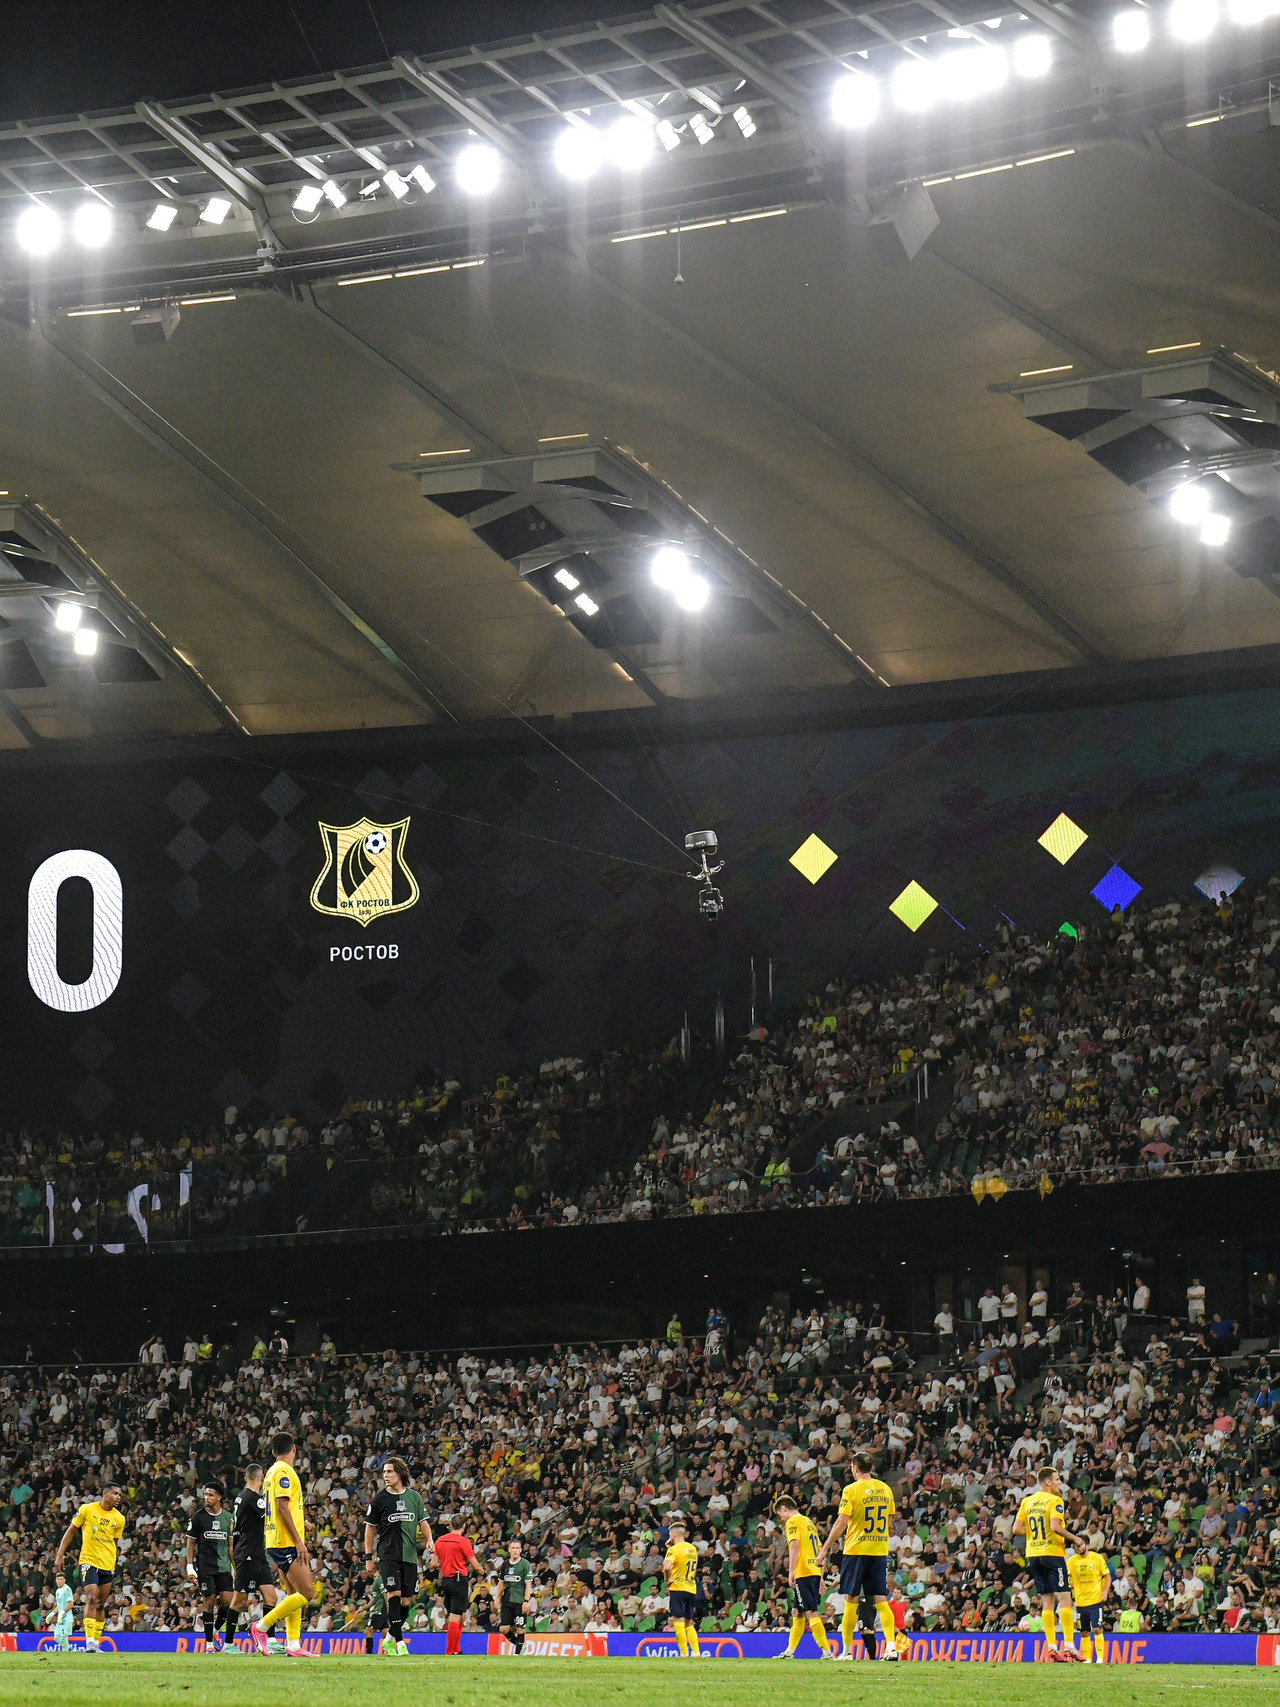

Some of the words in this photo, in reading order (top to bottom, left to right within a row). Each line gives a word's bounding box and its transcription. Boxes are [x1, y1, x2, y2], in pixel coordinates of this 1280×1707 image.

[340, 900, 354, 909] ФК
[356, 898, 389, 908] РОСТОВ
[27, 849, 123, 1013] 0
[329, 944, 399, 962] РОСТОВ
[863, 1505, 888, 1534] 55
[1028, 1515, 1047, 1541] 91
[686, 1560, 697, 1580] 15
